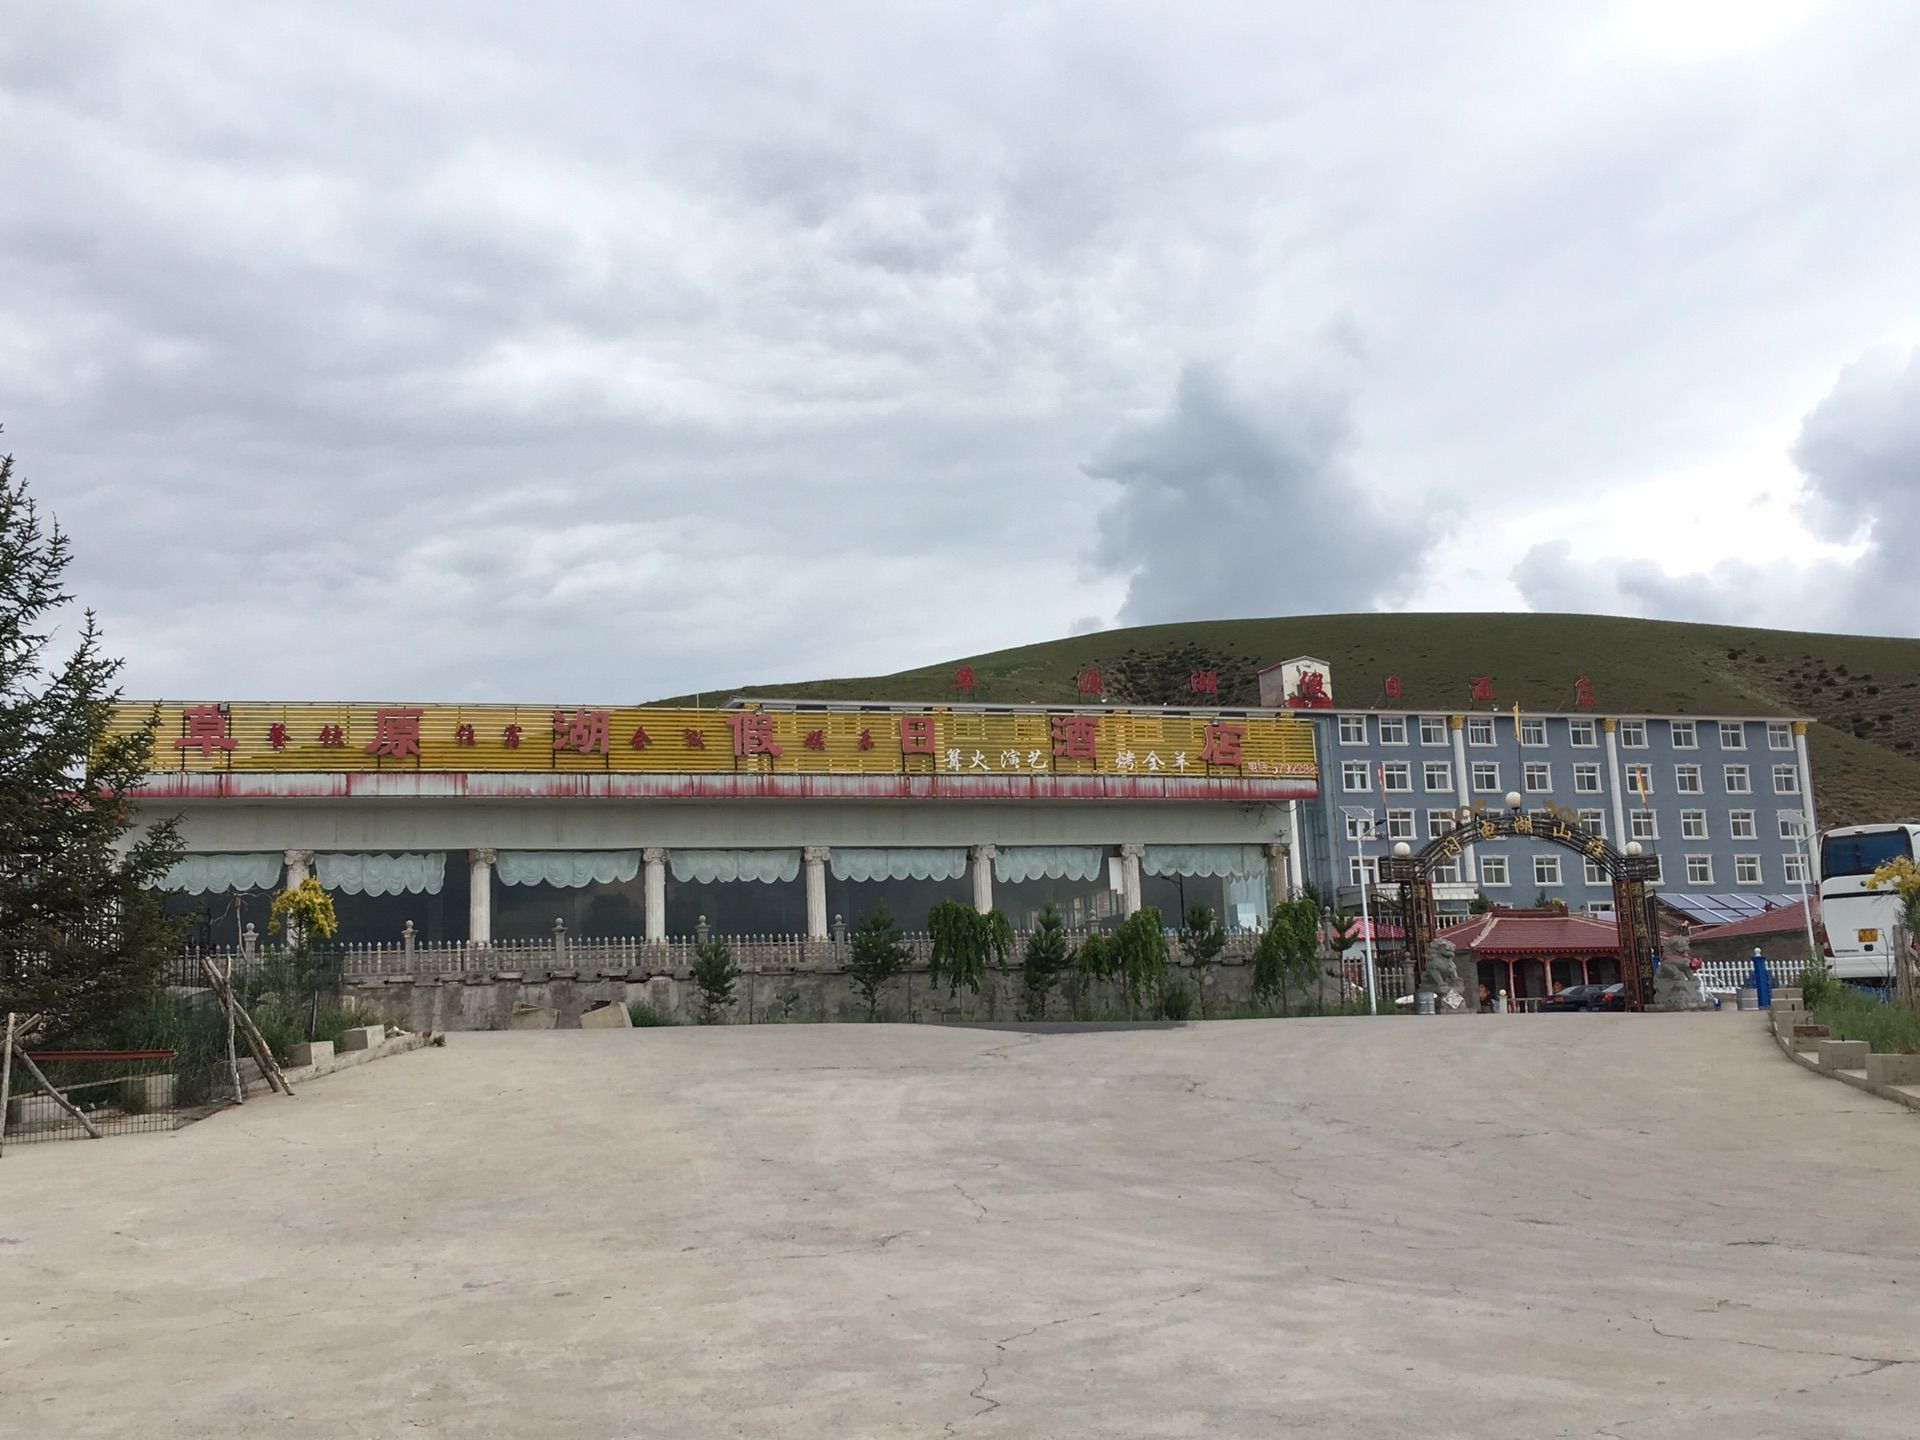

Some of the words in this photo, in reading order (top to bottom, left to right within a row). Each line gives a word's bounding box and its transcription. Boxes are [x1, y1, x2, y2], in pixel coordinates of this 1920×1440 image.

[175, 704, 1247, 767] 草原湖假日酒店
[1115, 750, 1190, 773] 烤全羊
